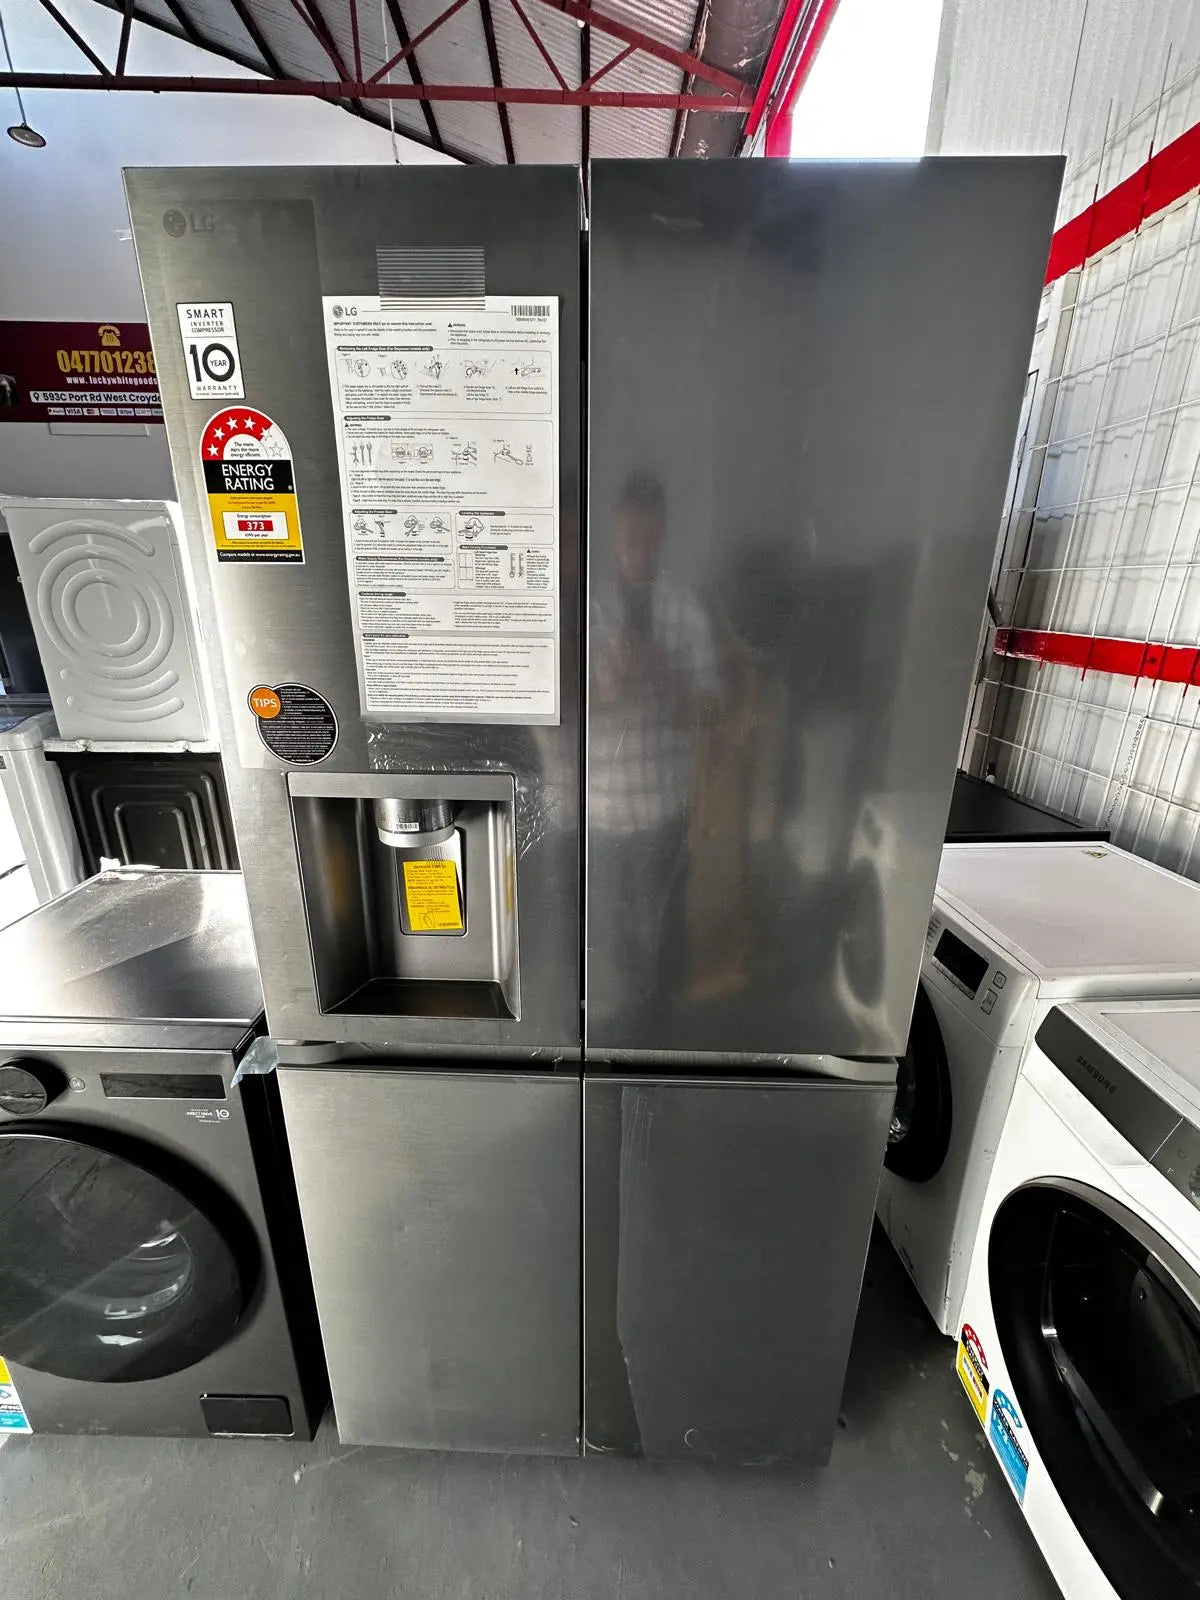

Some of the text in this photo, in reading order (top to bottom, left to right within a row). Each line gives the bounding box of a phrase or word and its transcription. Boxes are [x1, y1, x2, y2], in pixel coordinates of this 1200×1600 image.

[190, 213, 215, 233] LG
[186, 309, 225, 319] SMART
[344, 306, 358, 316] LG
[189, 343, 236, 382] 10
[43, 393, 67, 401] 593C
[90, 394, 102, 402] Rd
[103, 394, 127, 402] West
[222, 464, 273, 476] ENERGY
[224, 478, 274, 490] RATING
[246, 521, 265, 531] 373
[252, 698, 278, 708] TIPS
